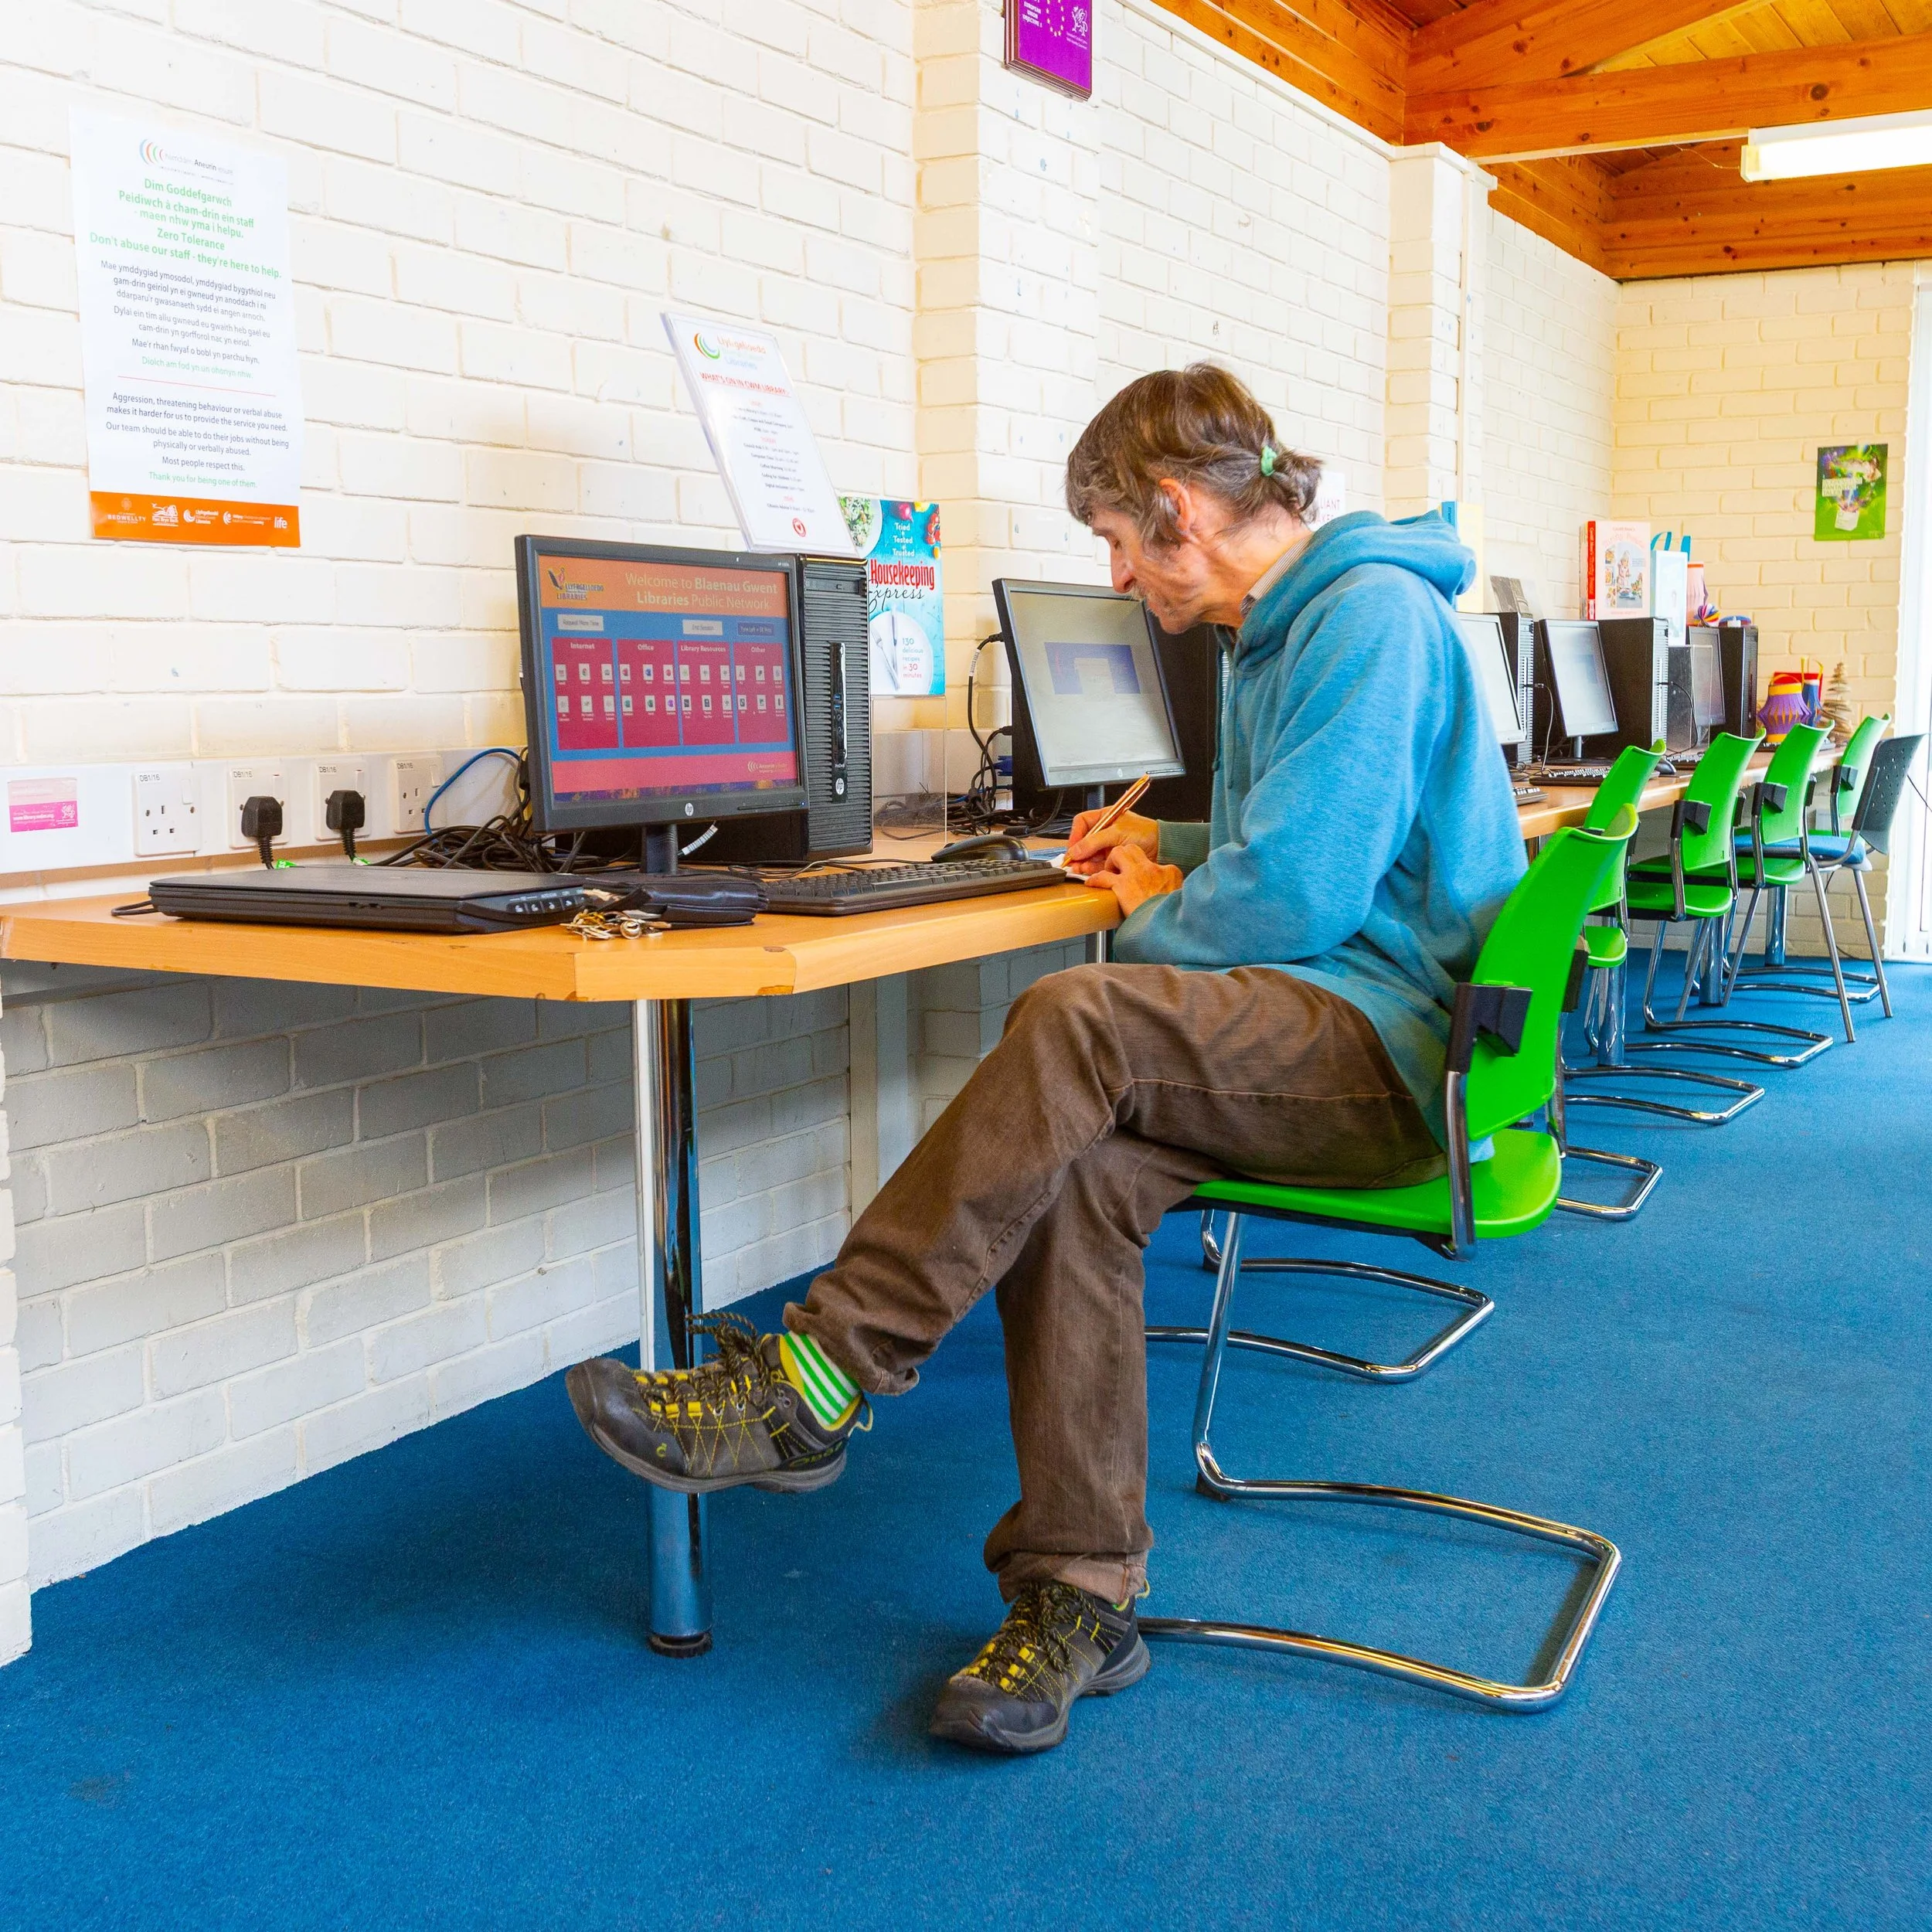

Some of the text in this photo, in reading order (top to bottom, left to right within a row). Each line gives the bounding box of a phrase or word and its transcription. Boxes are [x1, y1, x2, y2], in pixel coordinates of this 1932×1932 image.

[195, 159, 216, 171] Aneurin
[144, 178, 231, 206] Dim Goddefgarwch
[119, 190, 162, 209] Peidiwch
[173, 202, 219, 220] cham-drin
[221, 213, 234, 223] ein
[236, 217, 253, 227] staff
[140, 209, 166, 222] maen
[168, 213, 189, 226] nhw
[191, 219, 210, 230] yma
[216, 223, 243, 238] helpu.
[157, 227, 224, 250] Zero Tolerance
[90, 231, 281, 279] Don't abuse our staff they're here to help.
[100, 260, 116, 270] Mae
[118, 265, 158, 278] ymddygiad
[159, 272, 194, 285] ymosodol,
[195, 278, 232, 291] ymddygiad
[233, 284, 263, 297] bygythiol
[113, 277, 145, 288] gam-drin
[147, 282, 168, 292] geiriol
[186, 290, 213, 300] gwneud
[224, 297, 255, 308] anoddach
[132, 338, 151, 348] Mae'r
[153, 341, 168, 351] rhan
[170, 342, 189, 354] fwyaf
[196, 347, 211, 356] bobl
[107, 405, 130, 414] makes
[131, 406, 137, 415] it
[138, 407, 162, 417] harder
[163, 410, 173, 419] for
[192, 415, 219, 424] provide
[220, 417, 231, 425] the
[113, 392, 155, 405] Aggression,
[156, 397, 196, 411] threatening
[198, 401, 232, 413] behaviour
[242, 407, 262, 416] verbal
[264, 409, 281, 419] abuse
[106, 421, 119, 430] Our
[121, 423, 140, 432] team
[141, 424, 166, 435] should
[168, 427, 177, 436] be
[178, 428, 192, 437] able
[202, 430, 212, 439] do
[213, 432, 228, 440] their
[230, 434, 243, 444] jobs
[244, 435, 270, 445] without
[271, 437, 288, 449] being
[153, 439, 187, 451] physically
[197, 444, 224, 454] verbally
[225, 445, 250, 455] abused.
[162, 456, 244, 471] Most people respect this.
[148, 471, 171, 481] Thank
[172, 474, 185, 483] you
[185, 474, 196, 482] for
[197, 475, 217, 486] being
[230, 478, 239, 486] of
[274, 516, 287, 529] life
[894, 522, 910, 531] Tried
[893, 536, 913, 544] Tested
[626, 573, 777, 594] Welcome to Blaenau Gwent
[870, 560, 934, 590] Housekeeping
[556, 593, 588, 601] LIBRARIES
[637, 592, 770, 609] Libraries Public Network
